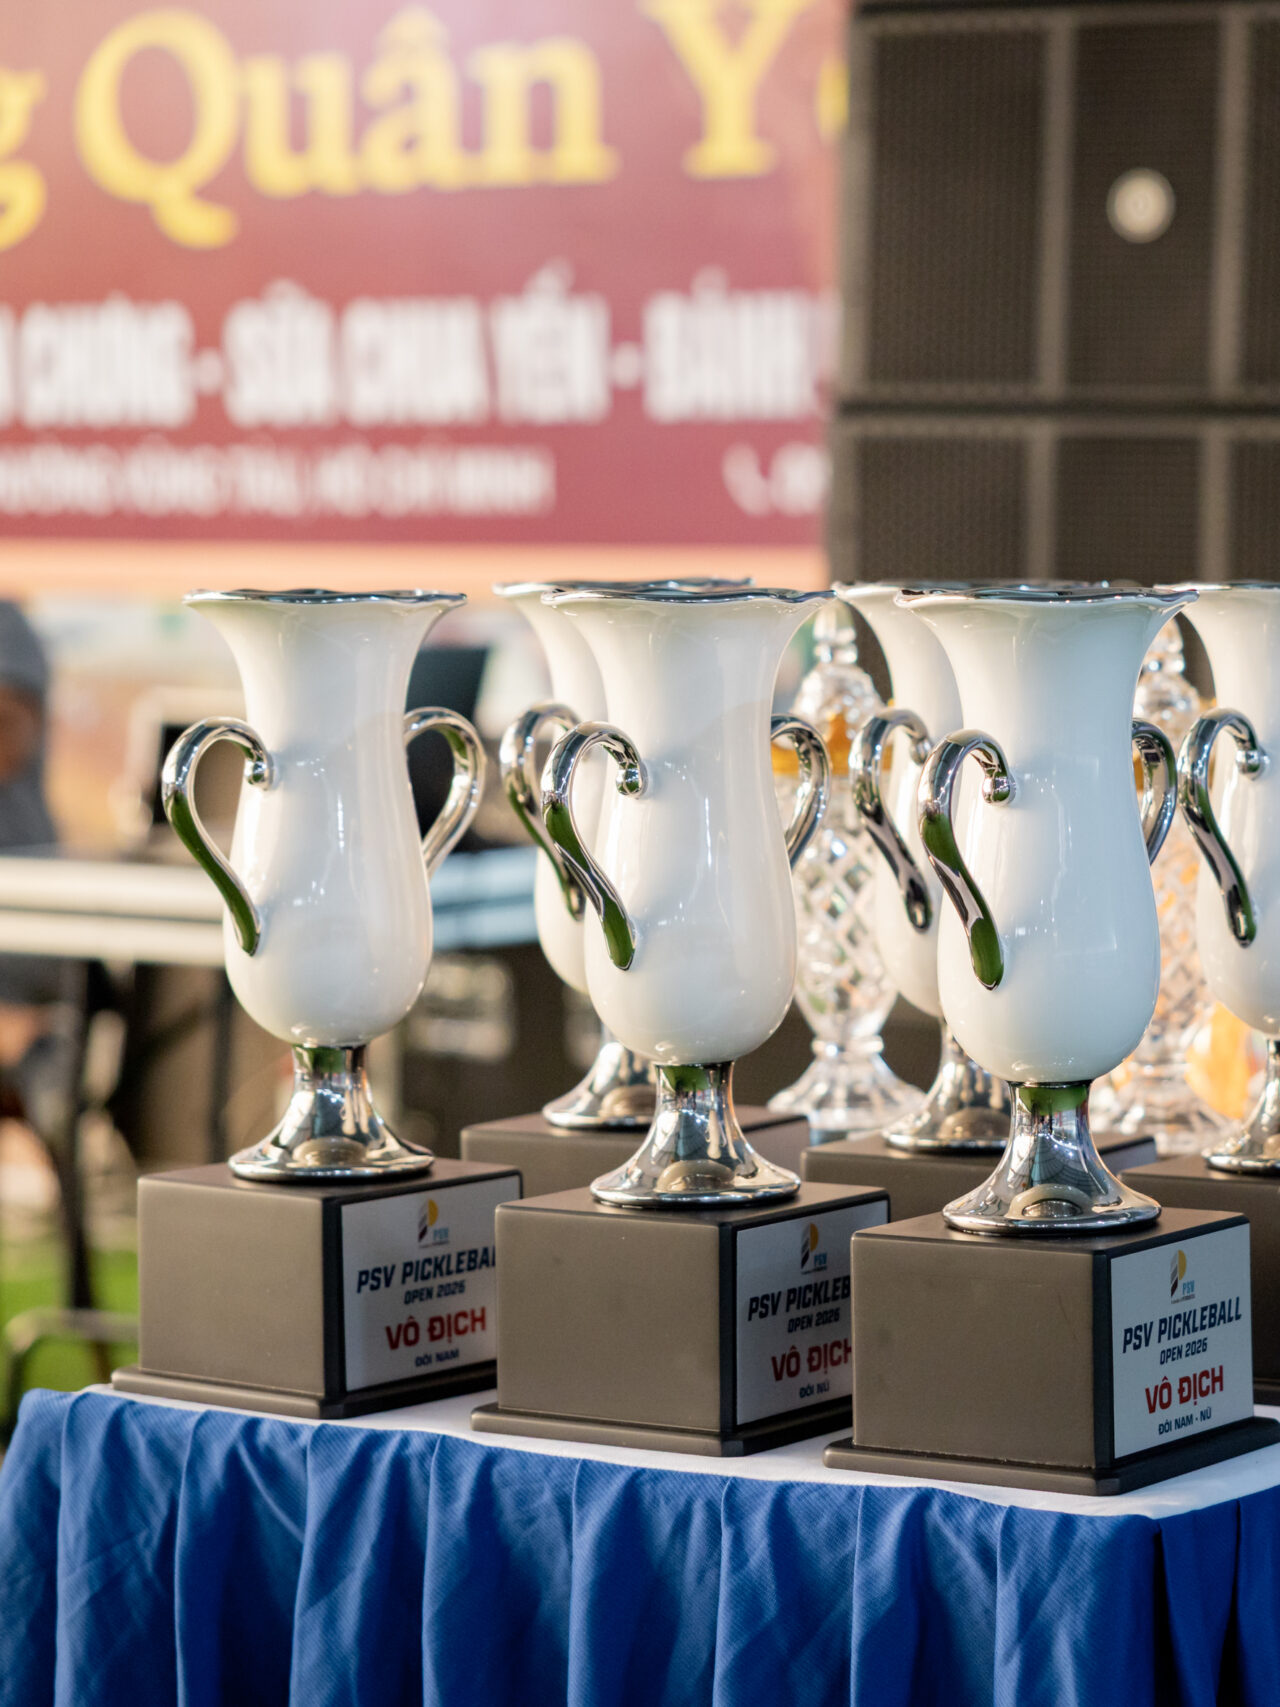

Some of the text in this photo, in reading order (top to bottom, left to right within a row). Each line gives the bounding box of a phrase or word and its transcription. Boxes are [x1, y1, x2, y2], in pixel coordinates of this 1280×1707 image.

[74, 6, 620, 249] Quân
[357, 1264, 396, 1294] PSV
[404, 1289, 433, 1305] OPEN
[748, 1291, 781, 1322] PSV
[385, 1306, 486, 1351] VÔ ĐỊCH
[788, 1307, 841, 1333] OPEN 2026
[1122, 1296, 1242, 1353] PSV PICKLEBALL
[771, 1345, 800, 1382] VÔ
[1160, 1337, 1208, 1365] OPEN 2026
[1145, 1365, 1224, 1414] VÔ ĐỊCH
[1174, 1413, 1194, 1430] NAM
